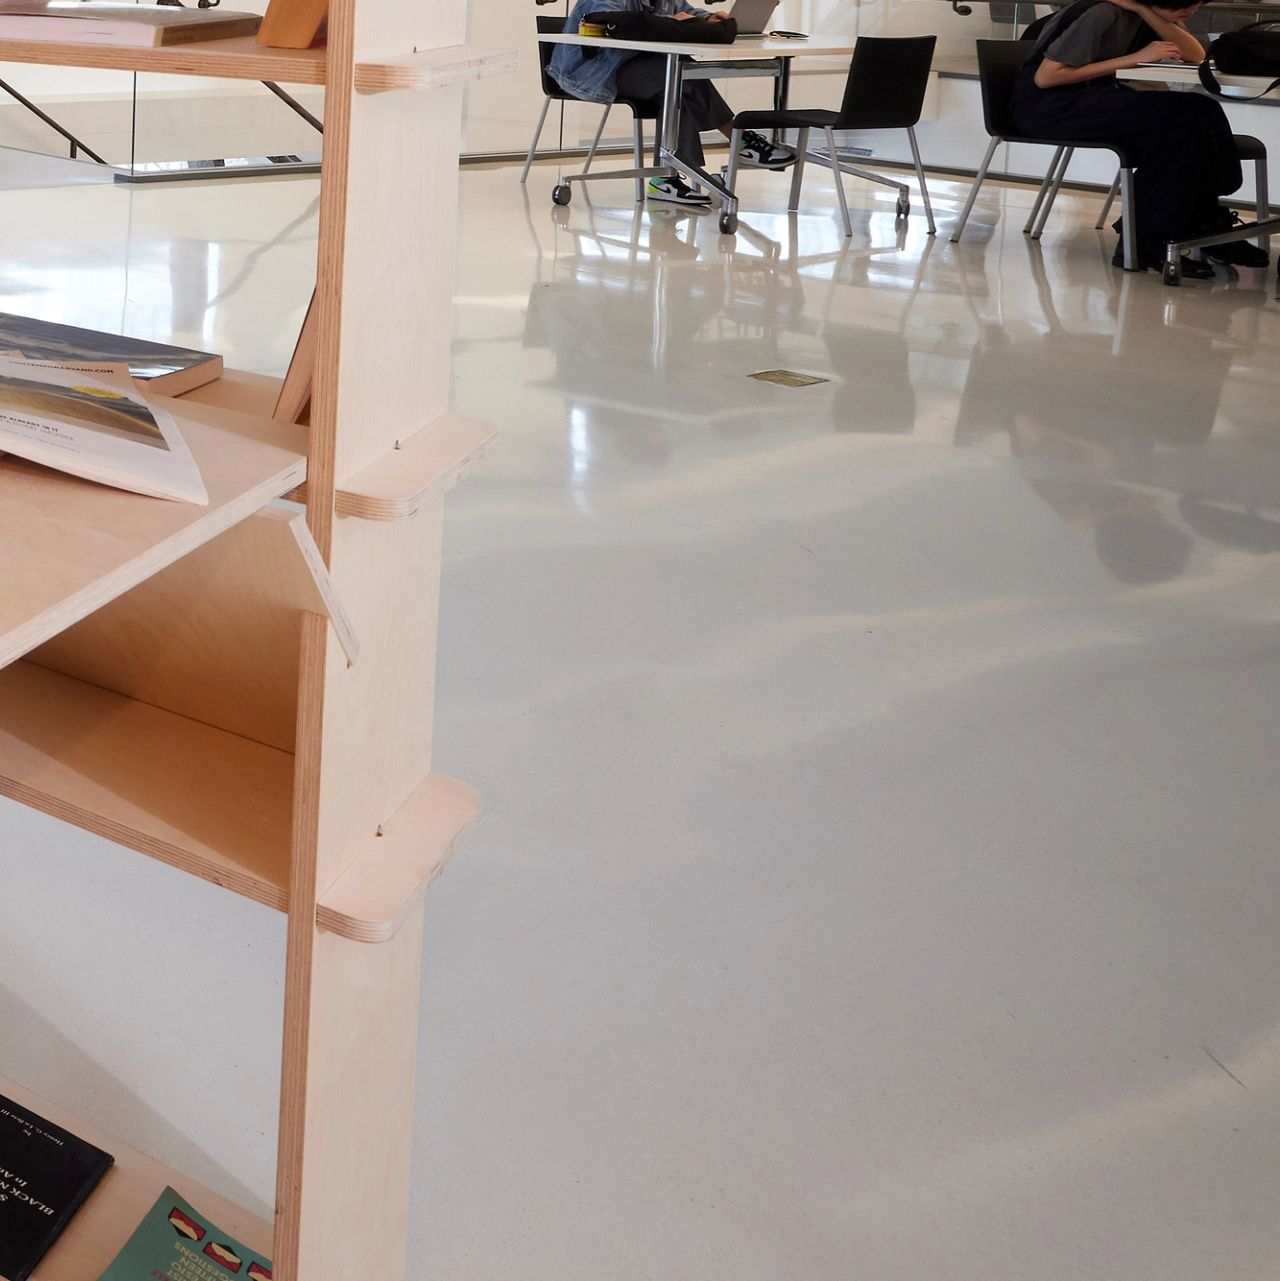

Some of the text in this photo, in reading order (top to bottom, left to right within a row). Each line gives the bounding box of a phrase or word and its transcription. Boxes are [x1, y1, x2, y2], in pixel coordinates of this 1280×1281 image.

[21, 1128, 33, 1137] by
[42, 1131, 65, 1147] Henry
[14, 1177, 29, 1188] In
[8, 1187, 55, 1216] BLACK
